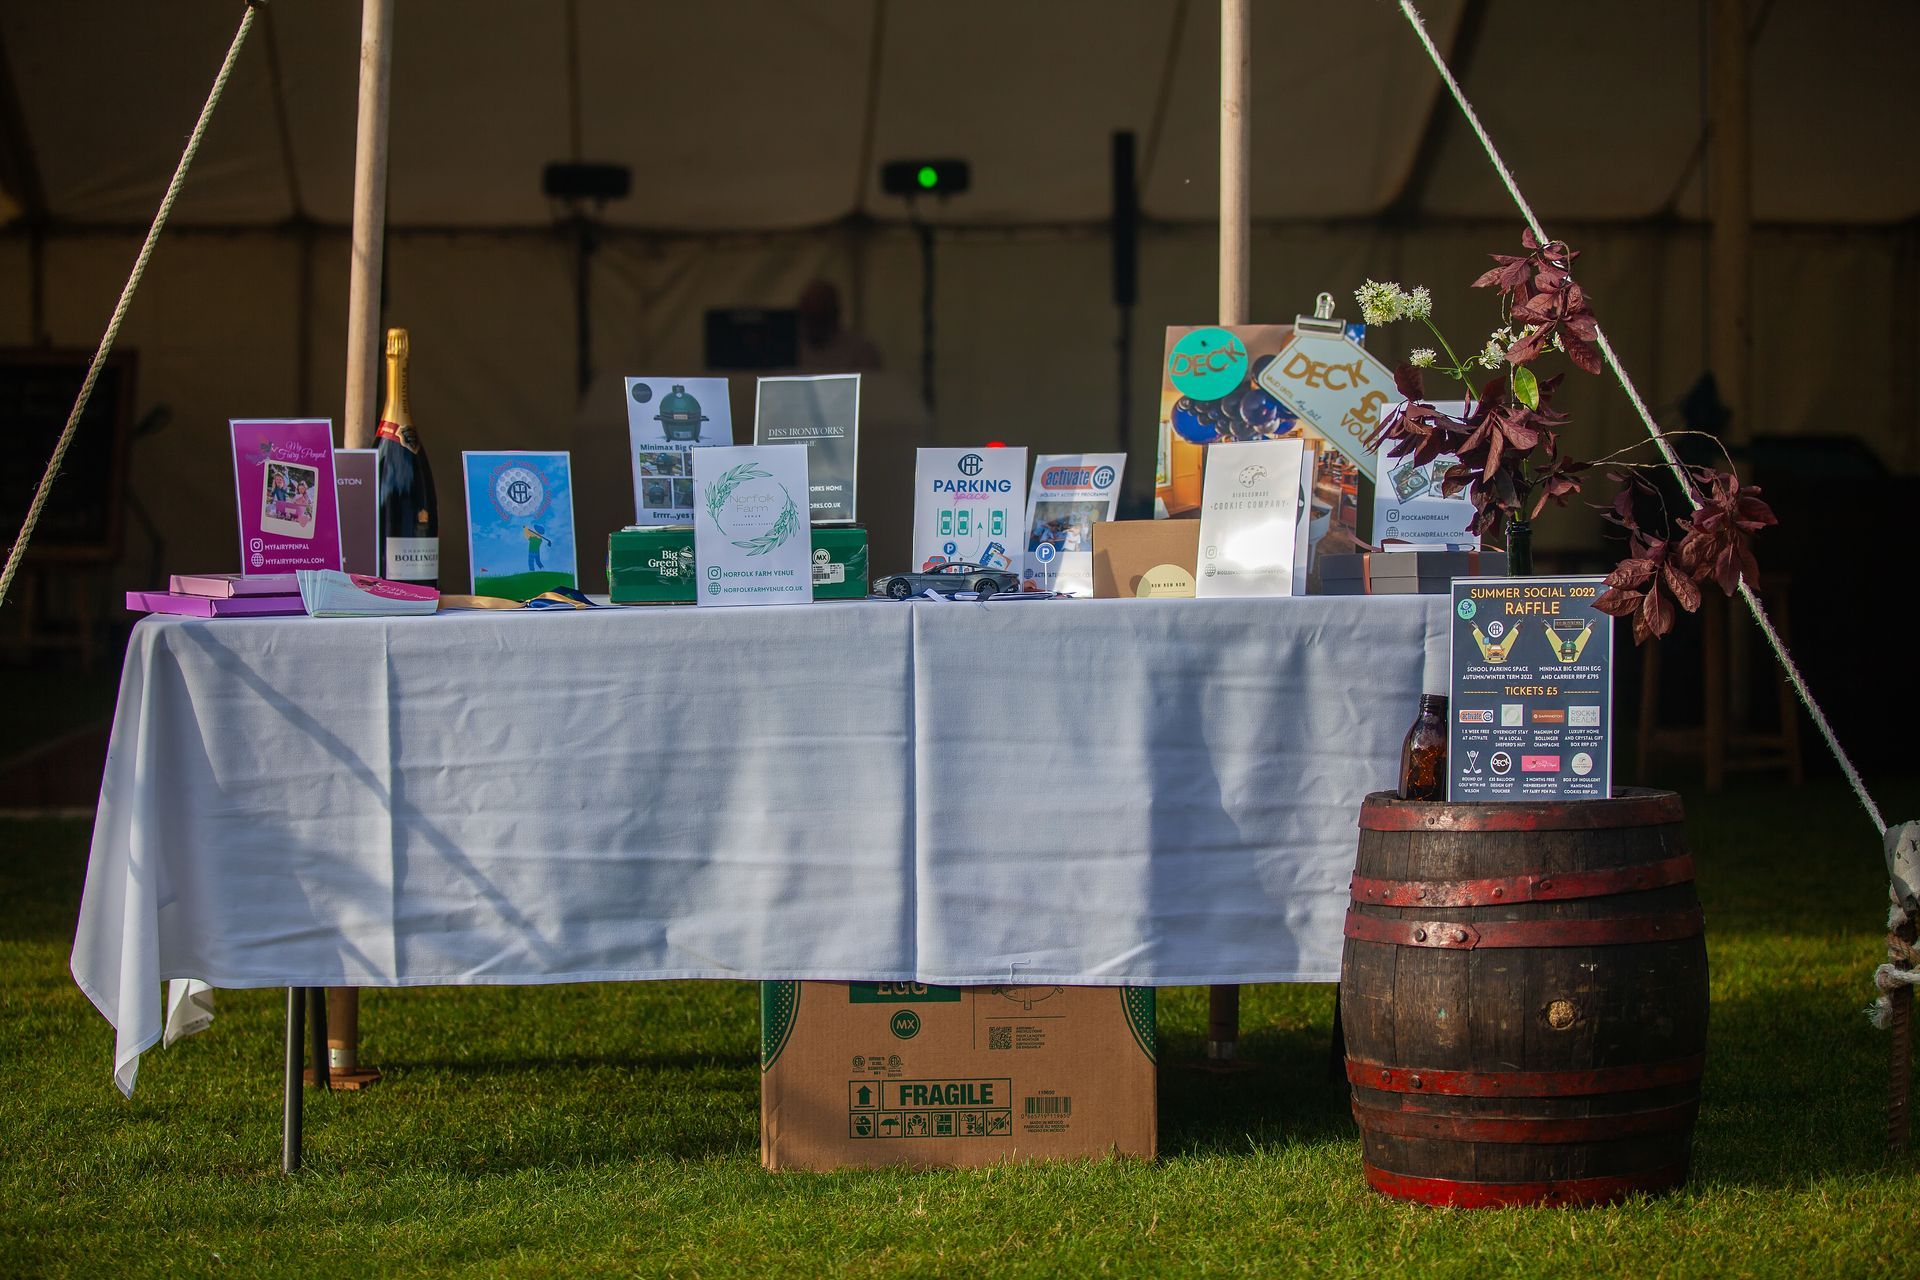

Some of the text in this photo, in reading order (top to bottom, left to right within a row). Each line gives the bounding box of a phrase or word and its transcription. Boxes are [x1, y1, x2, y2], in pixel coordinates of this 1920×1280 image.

[1170, 340, 1246, 377] DECK
[1282, 351, 1371, 391] DECK
[769, 426, 844, 437] DISS IRONWORKS
[640, 444, 673, 453] Minimax
[675, 444, 687, 455] Big
[337, 478, 363, 486] GTON
[1046, 468, 1089, 487] activate
[826, 484, 842, 492] HOME
[933, 479, 1012, 493] PARKING
[737, 504, 769, 513] Farm
[1213, 499, 1286, 511] COOKIE COMPANY
[265, 543, 310, 552] MYFAIRYPENPAL
[662, 550, 678, 561] Big
[1042, 549, 1049, 558] P
[265, 557, 325, 565] MYFAIRYPENPAL.COM
[648, 559, 678, 568] Green
[660, 567, 678, 578] Egg
[723, 570, 754, 578] NORFOLK
[723, 584, 804, 593] NORFOLKFARMVENUE.CO.UK
[1470, 587, 1596, 599] SUMMER SOCIAL 2022
[1505, 601, 1560, 615] RAFFLE
[1504, 686, 1558, 696] TICKETS £5
[1492, 758, 1510, 767] DECK
[896, 1019, 915, 1030] MX
[899, 1083, 995, 1106] FRAGILE
